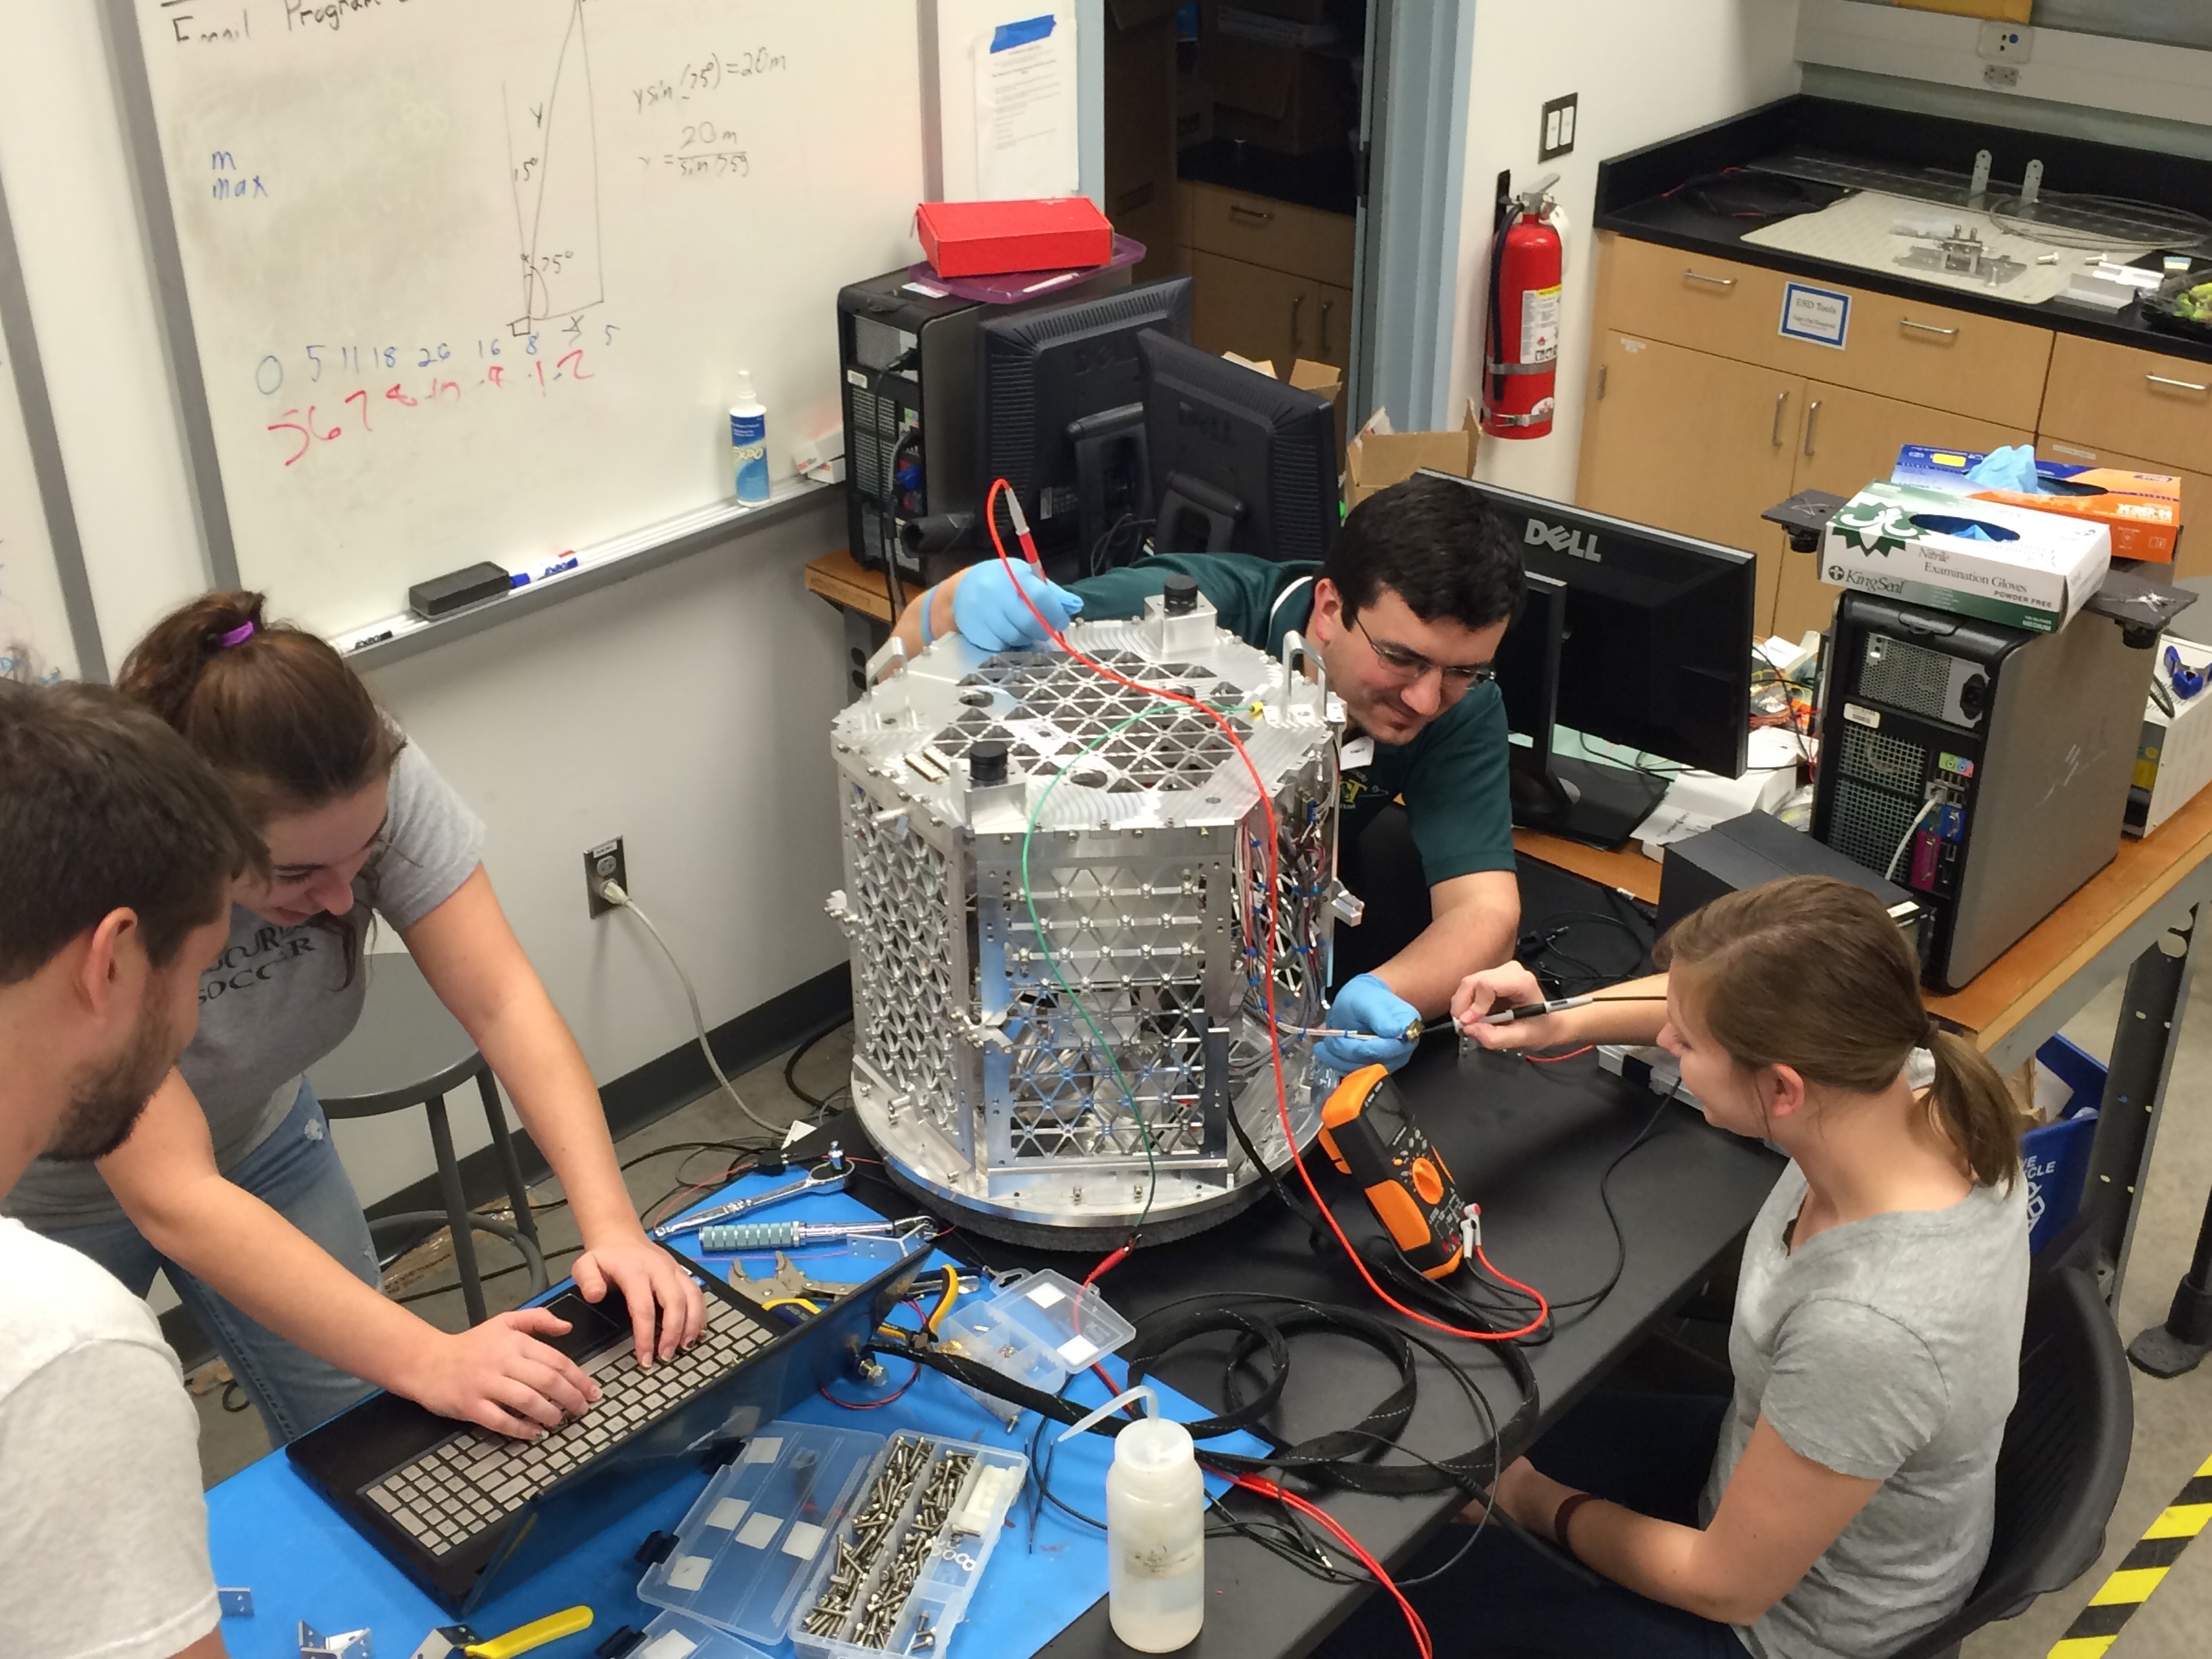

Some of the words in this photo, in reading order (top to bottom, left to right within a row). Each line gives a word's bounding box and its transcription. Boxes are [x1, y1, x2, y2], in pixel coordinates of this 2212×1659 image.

[211, 175, 268, 200] max
[1795, 298, 1815, 310] ESD
[255, 354, 283, 395] 0
[306, 344, 325, 382] 5
[373, 346, 398, 368] 18
[477, 339, 501, 358] 16
[605, 324, 621, 346] 5
[307, 405, 342, 441] 6
[344, 390, 373, 432] 7
[1523, 518, 1601, 563] DELL
[1924, 561, 1989, 586] Examination
[1991, 576, 2028, 593] Gloves
[1994, 590, 2029, 603] POWDER
[2030, 598, 2053, 608] FREE
[199, 937, 315, 1004] SOCCR
